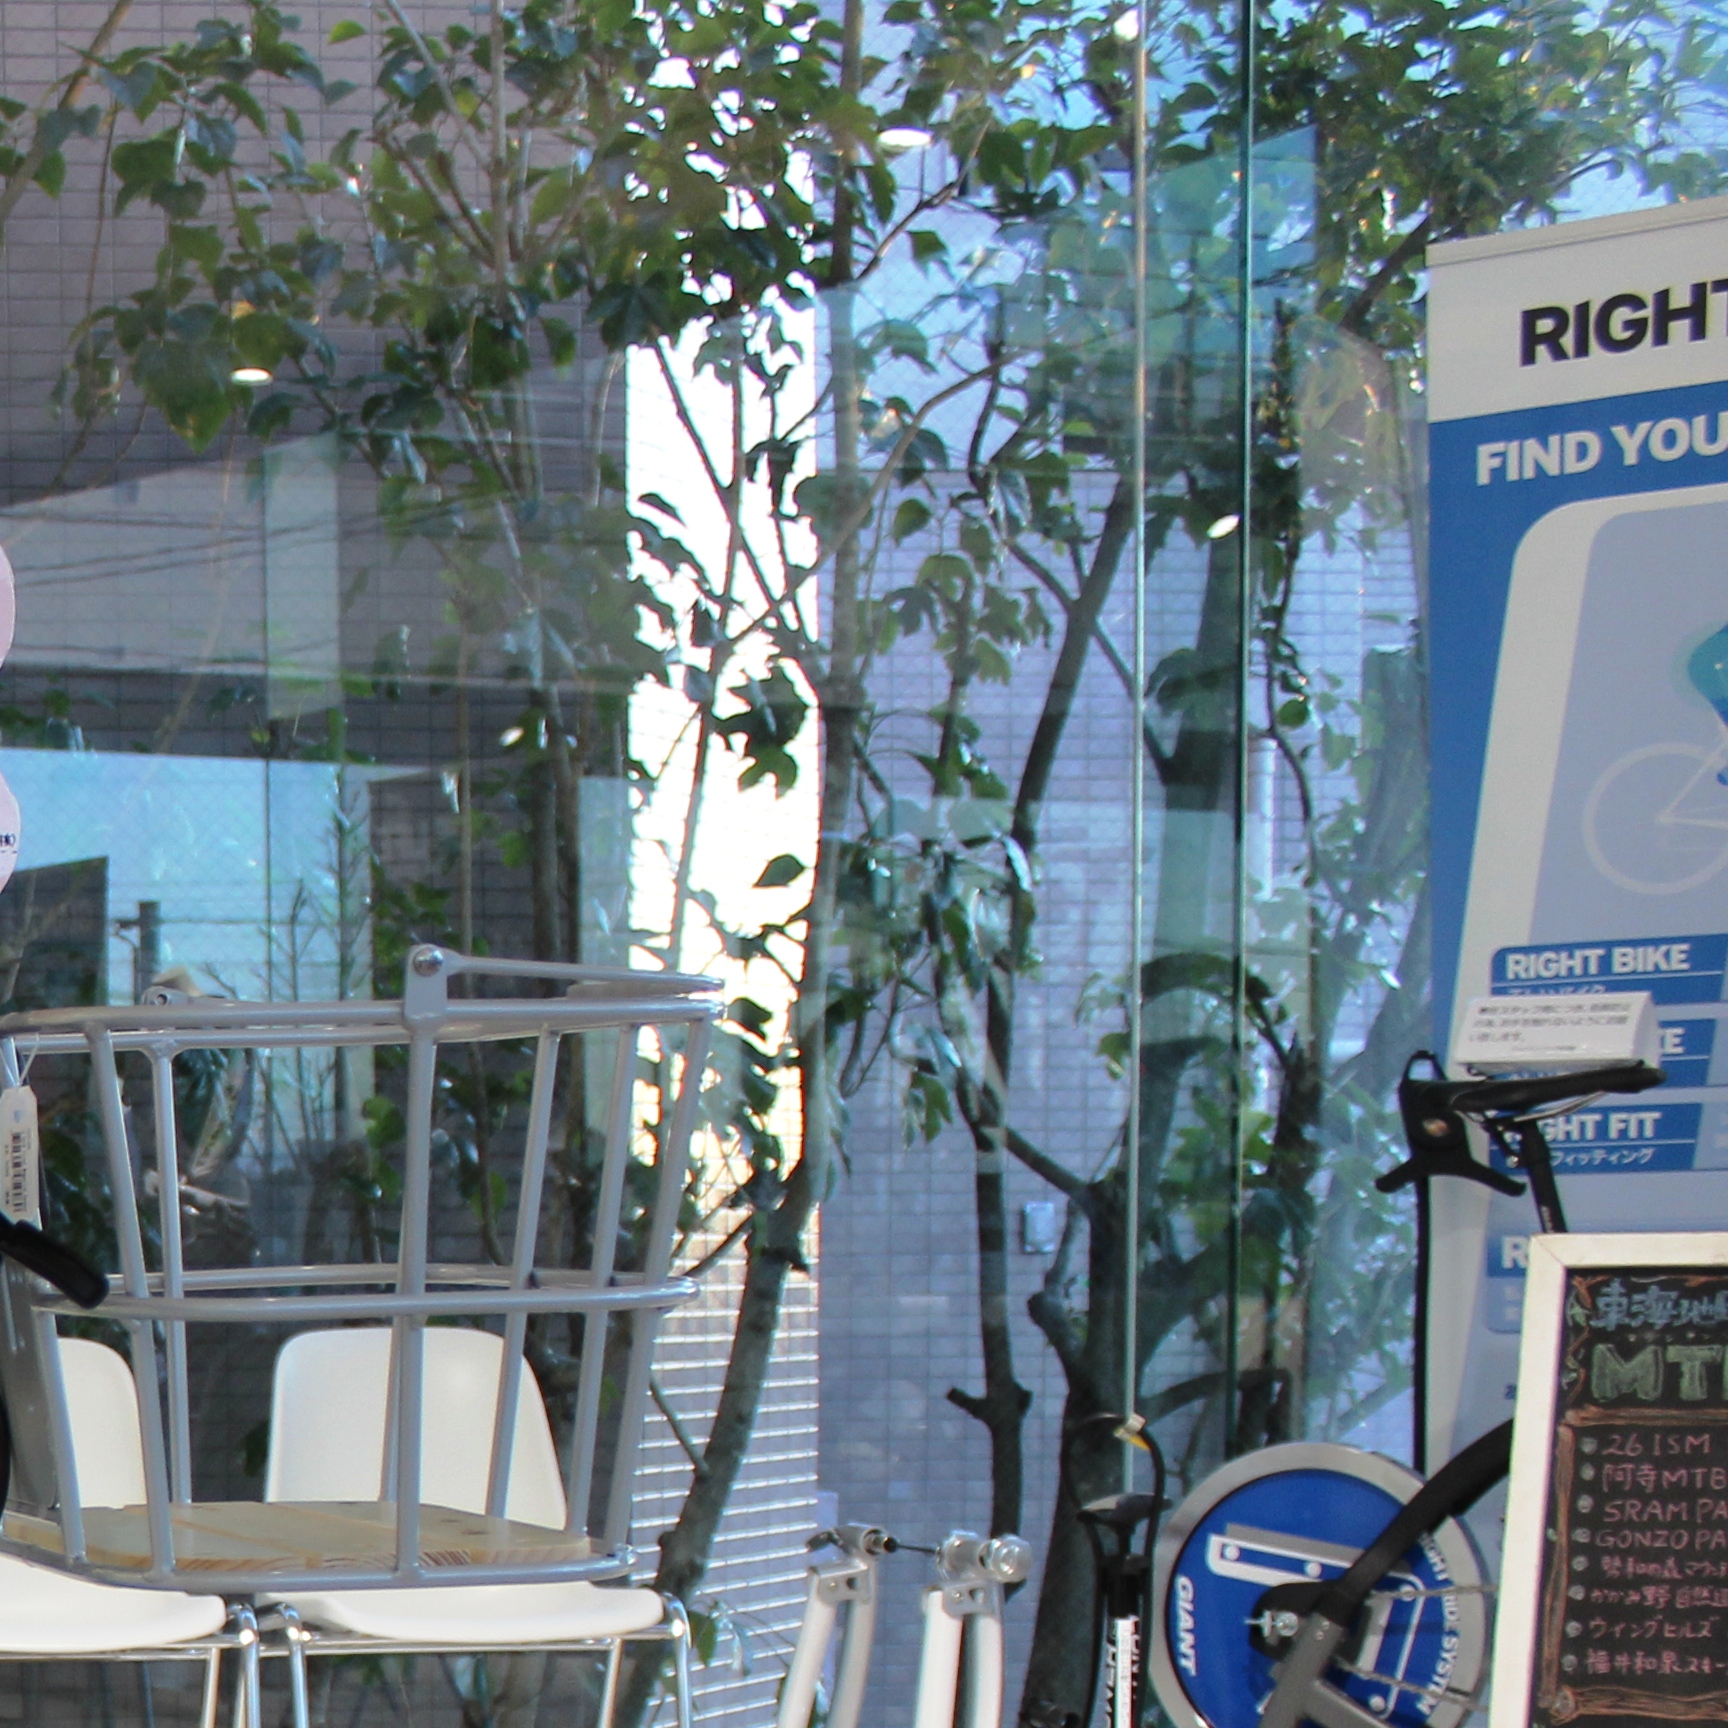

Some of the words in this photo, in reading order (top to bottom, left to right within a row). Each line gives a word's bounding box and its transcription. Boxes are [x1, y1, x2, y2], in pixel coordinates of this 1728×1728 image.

[1475, 430, 1602, 487] FIND
[1505, 949, 1606, 981] RIGHT
[1611, 943, 1692, 974] BIKE
[1609, 1111, 1662, 1140] FIT
[1602, 1432, 1645, 1457] 26
[1603, 1501, 1689, 1523] SRAM
[1595, 1529, 1689, 1549] GONZO
[1174, 1573, 1197, 1678] GIANT
